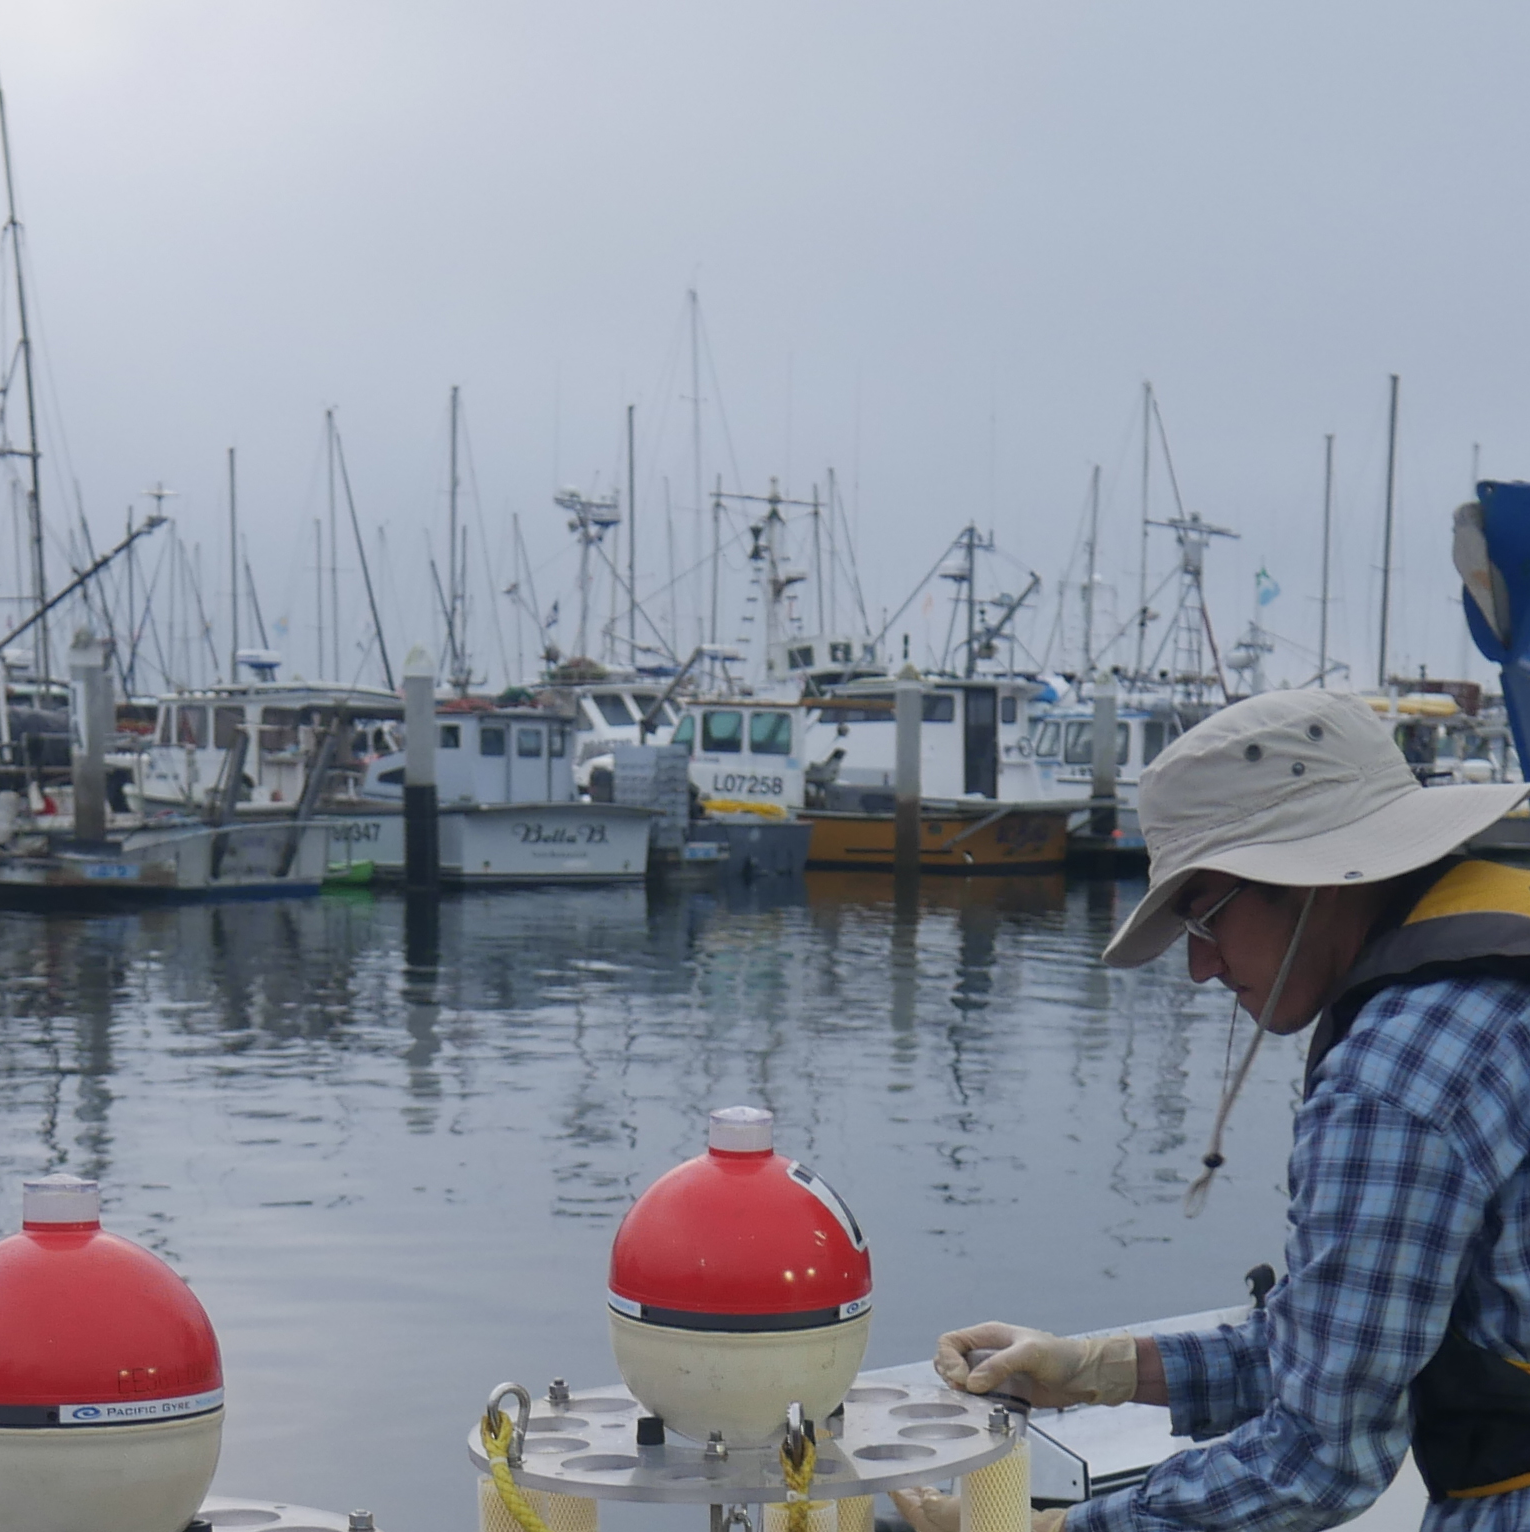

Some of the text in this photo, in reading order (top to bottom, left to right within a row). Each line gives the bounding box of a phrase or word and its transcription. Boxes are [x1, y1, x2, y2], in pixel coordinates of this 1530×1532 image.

[713, 773, 784, 795] L07258
[511, 822, 576, 844] Bella
[106, 1400, 191, 1417] PACIFIC GYRE
